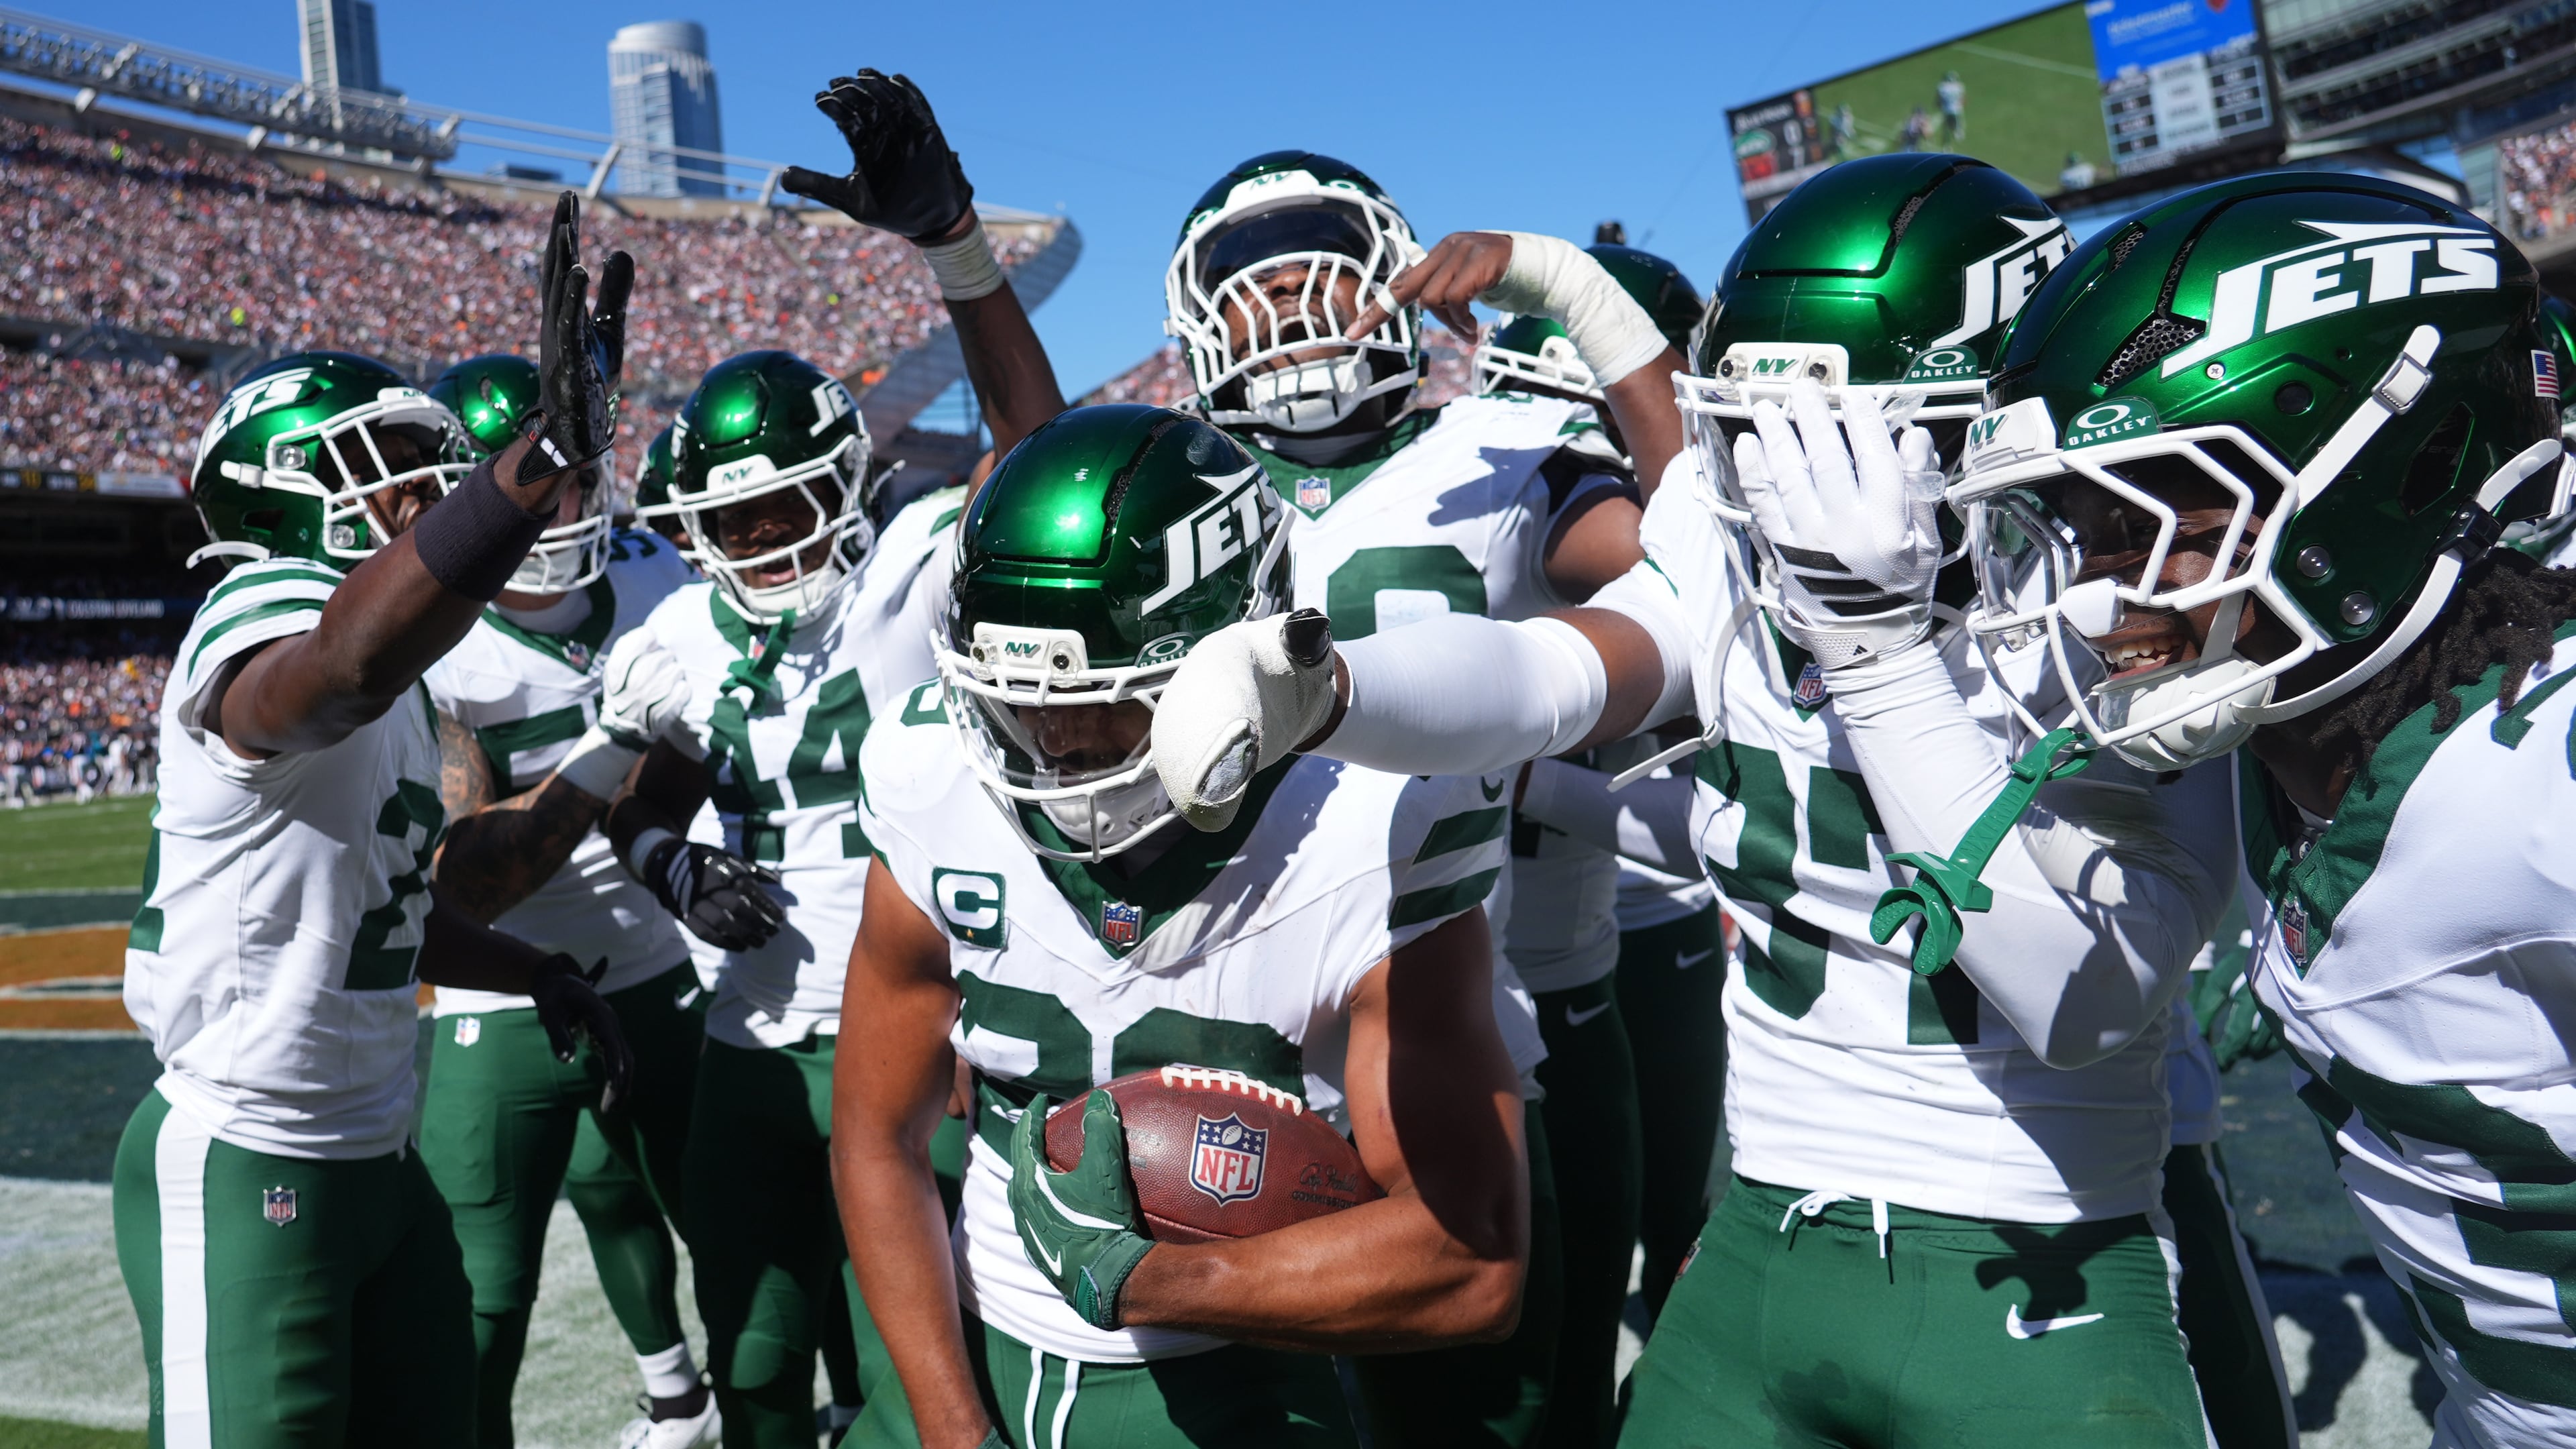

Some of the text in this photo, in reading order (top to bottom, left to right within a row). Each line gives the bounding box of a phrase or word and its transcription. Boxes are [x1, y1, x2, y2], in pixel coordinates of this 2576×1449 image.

[1931, 216, 2078, 350] JET
[2161, 221, 2498, 378] JETS
[1752, 358, 1799, 376] NY
[1911, 366, 1976, 378] OAKLEY
[809, 376, 851, 437] JE
[191, 367, 314, 492] ETS
[1970, 413, 2008, 453] NY
[2068, 415, 2151, 446] OAKLEY
[722, 466, 753, 485] NY
[1141, 463, 1284, 616] JETS
[1004, 641, 1041, 657] NY
[1799, 680, 1823, 699] NFL
[936, 873, 998, 930] C
[1106, 921, 1134, 941] NFL
[2285, 925, 2303, 955] NFL
[1198, 1146, 1254, 1194] NFL
